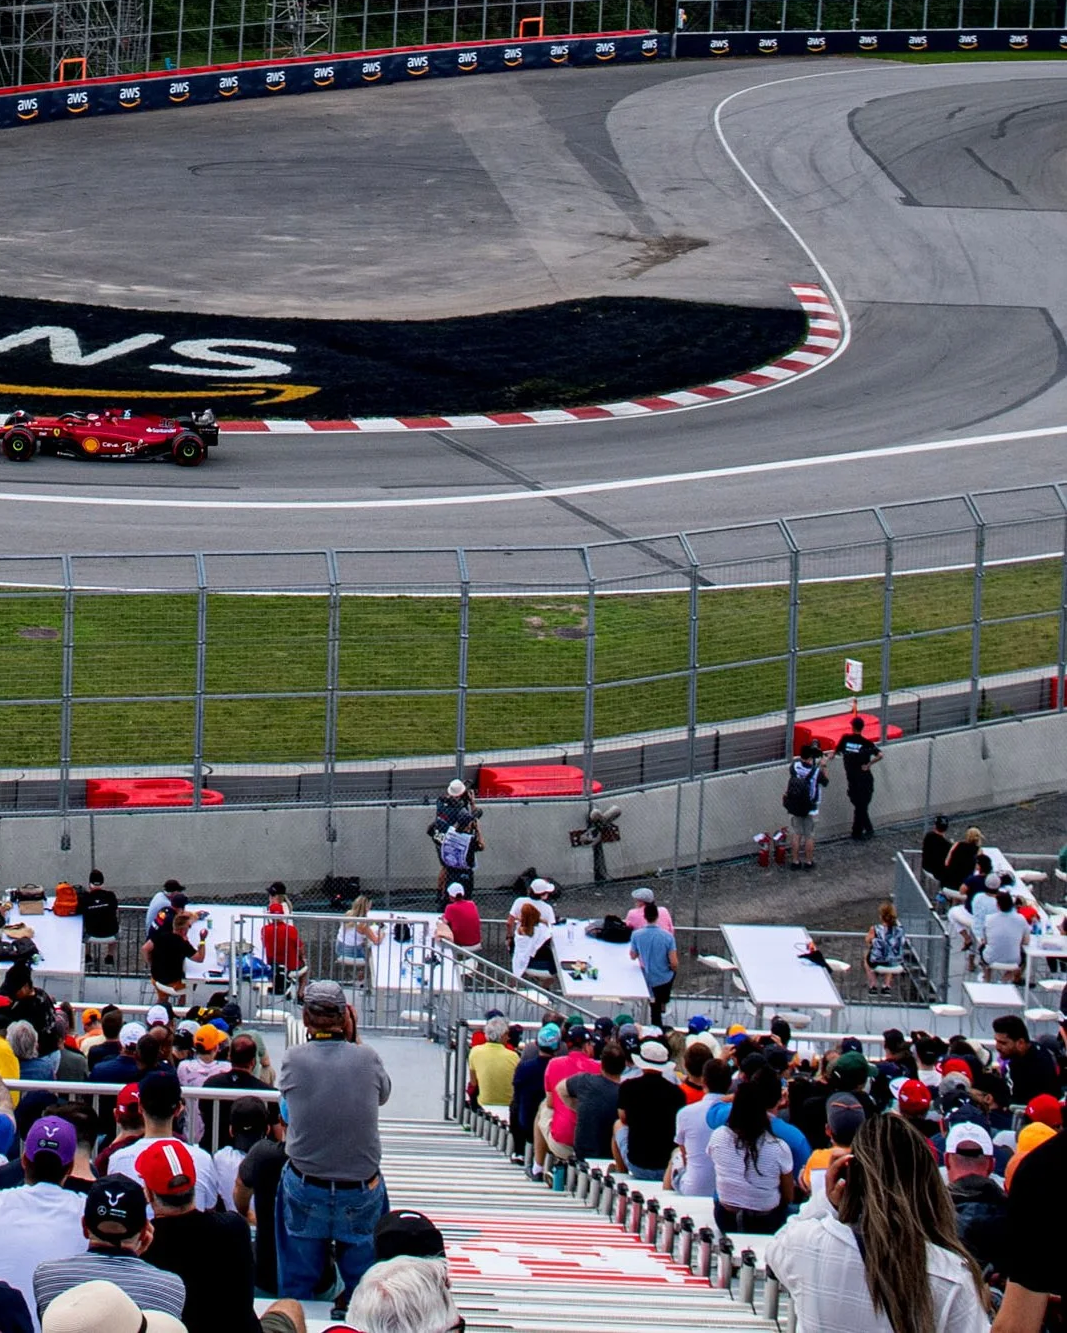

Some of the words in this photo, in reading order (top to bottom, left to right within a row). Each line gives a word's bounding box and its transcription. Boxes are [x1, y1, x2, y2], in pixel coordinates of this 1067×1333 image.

[642, 39, 657, 49] aws
[759, 39, 777, 47] aws
[909, 36, 927, 44] aws
[959, 35, 977, 43] aws
[1010, 35, 1027, 43] aws
[504, 48, 522, 58] aws
[551, 45, 569, 55] aws
[596, 43, 615, 52] aws
[407, 56, 428, 67] aws
[458, 52, 477, 63] aws
[314, 67, 334, 78] aws
[362, 62, 381, 73] aws
[220, 76, 238, 88] aws
[266, 71, 285, 82] aws
[120, 87, 140, 99] aws
[170, 82, 189, 93] aws
[67, 92, 87, 104] aws
[18, 98, 37, 111] aws
